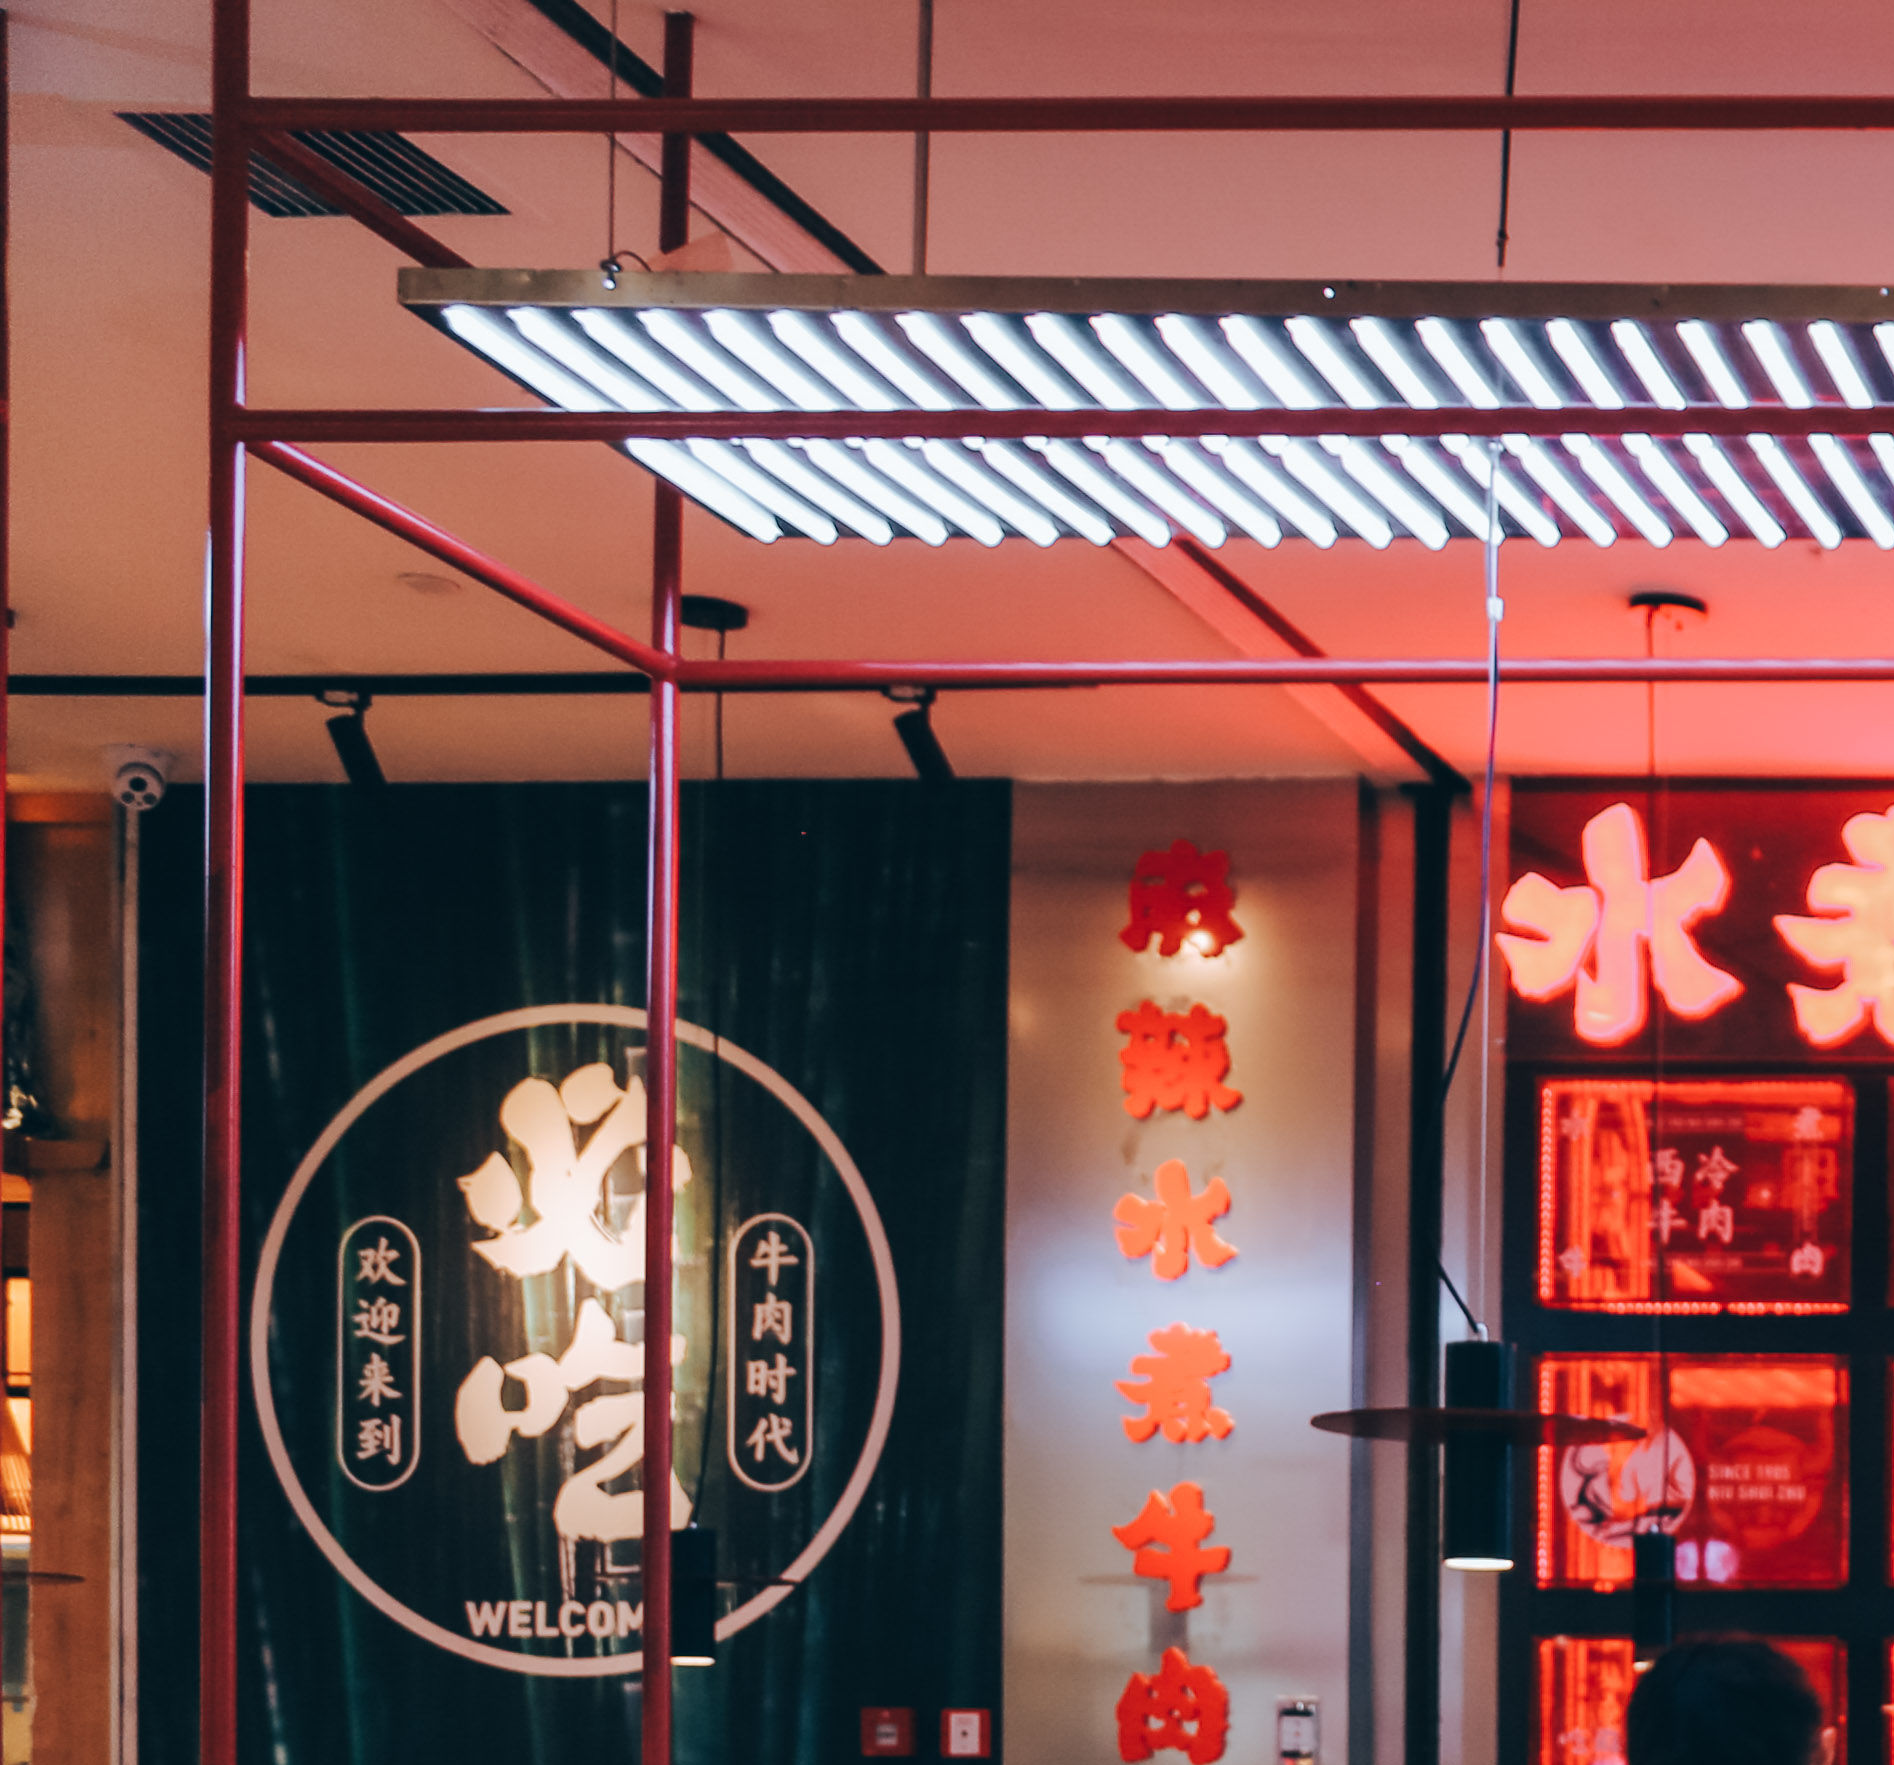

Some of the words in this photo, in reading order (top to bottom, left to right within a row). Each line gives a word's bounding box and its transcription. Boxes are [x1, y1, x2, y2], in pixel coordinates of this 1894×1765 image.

[455, 1062, 693, 1542] 必吃
[1649, 1199, 1735, 1246] 牛肉
[354, 1234, 406, 1464] 欢迎来到
[747, 1231, 799, 1466] 牛肉时代
[466, 1601, 643, 1638] WELCOM
